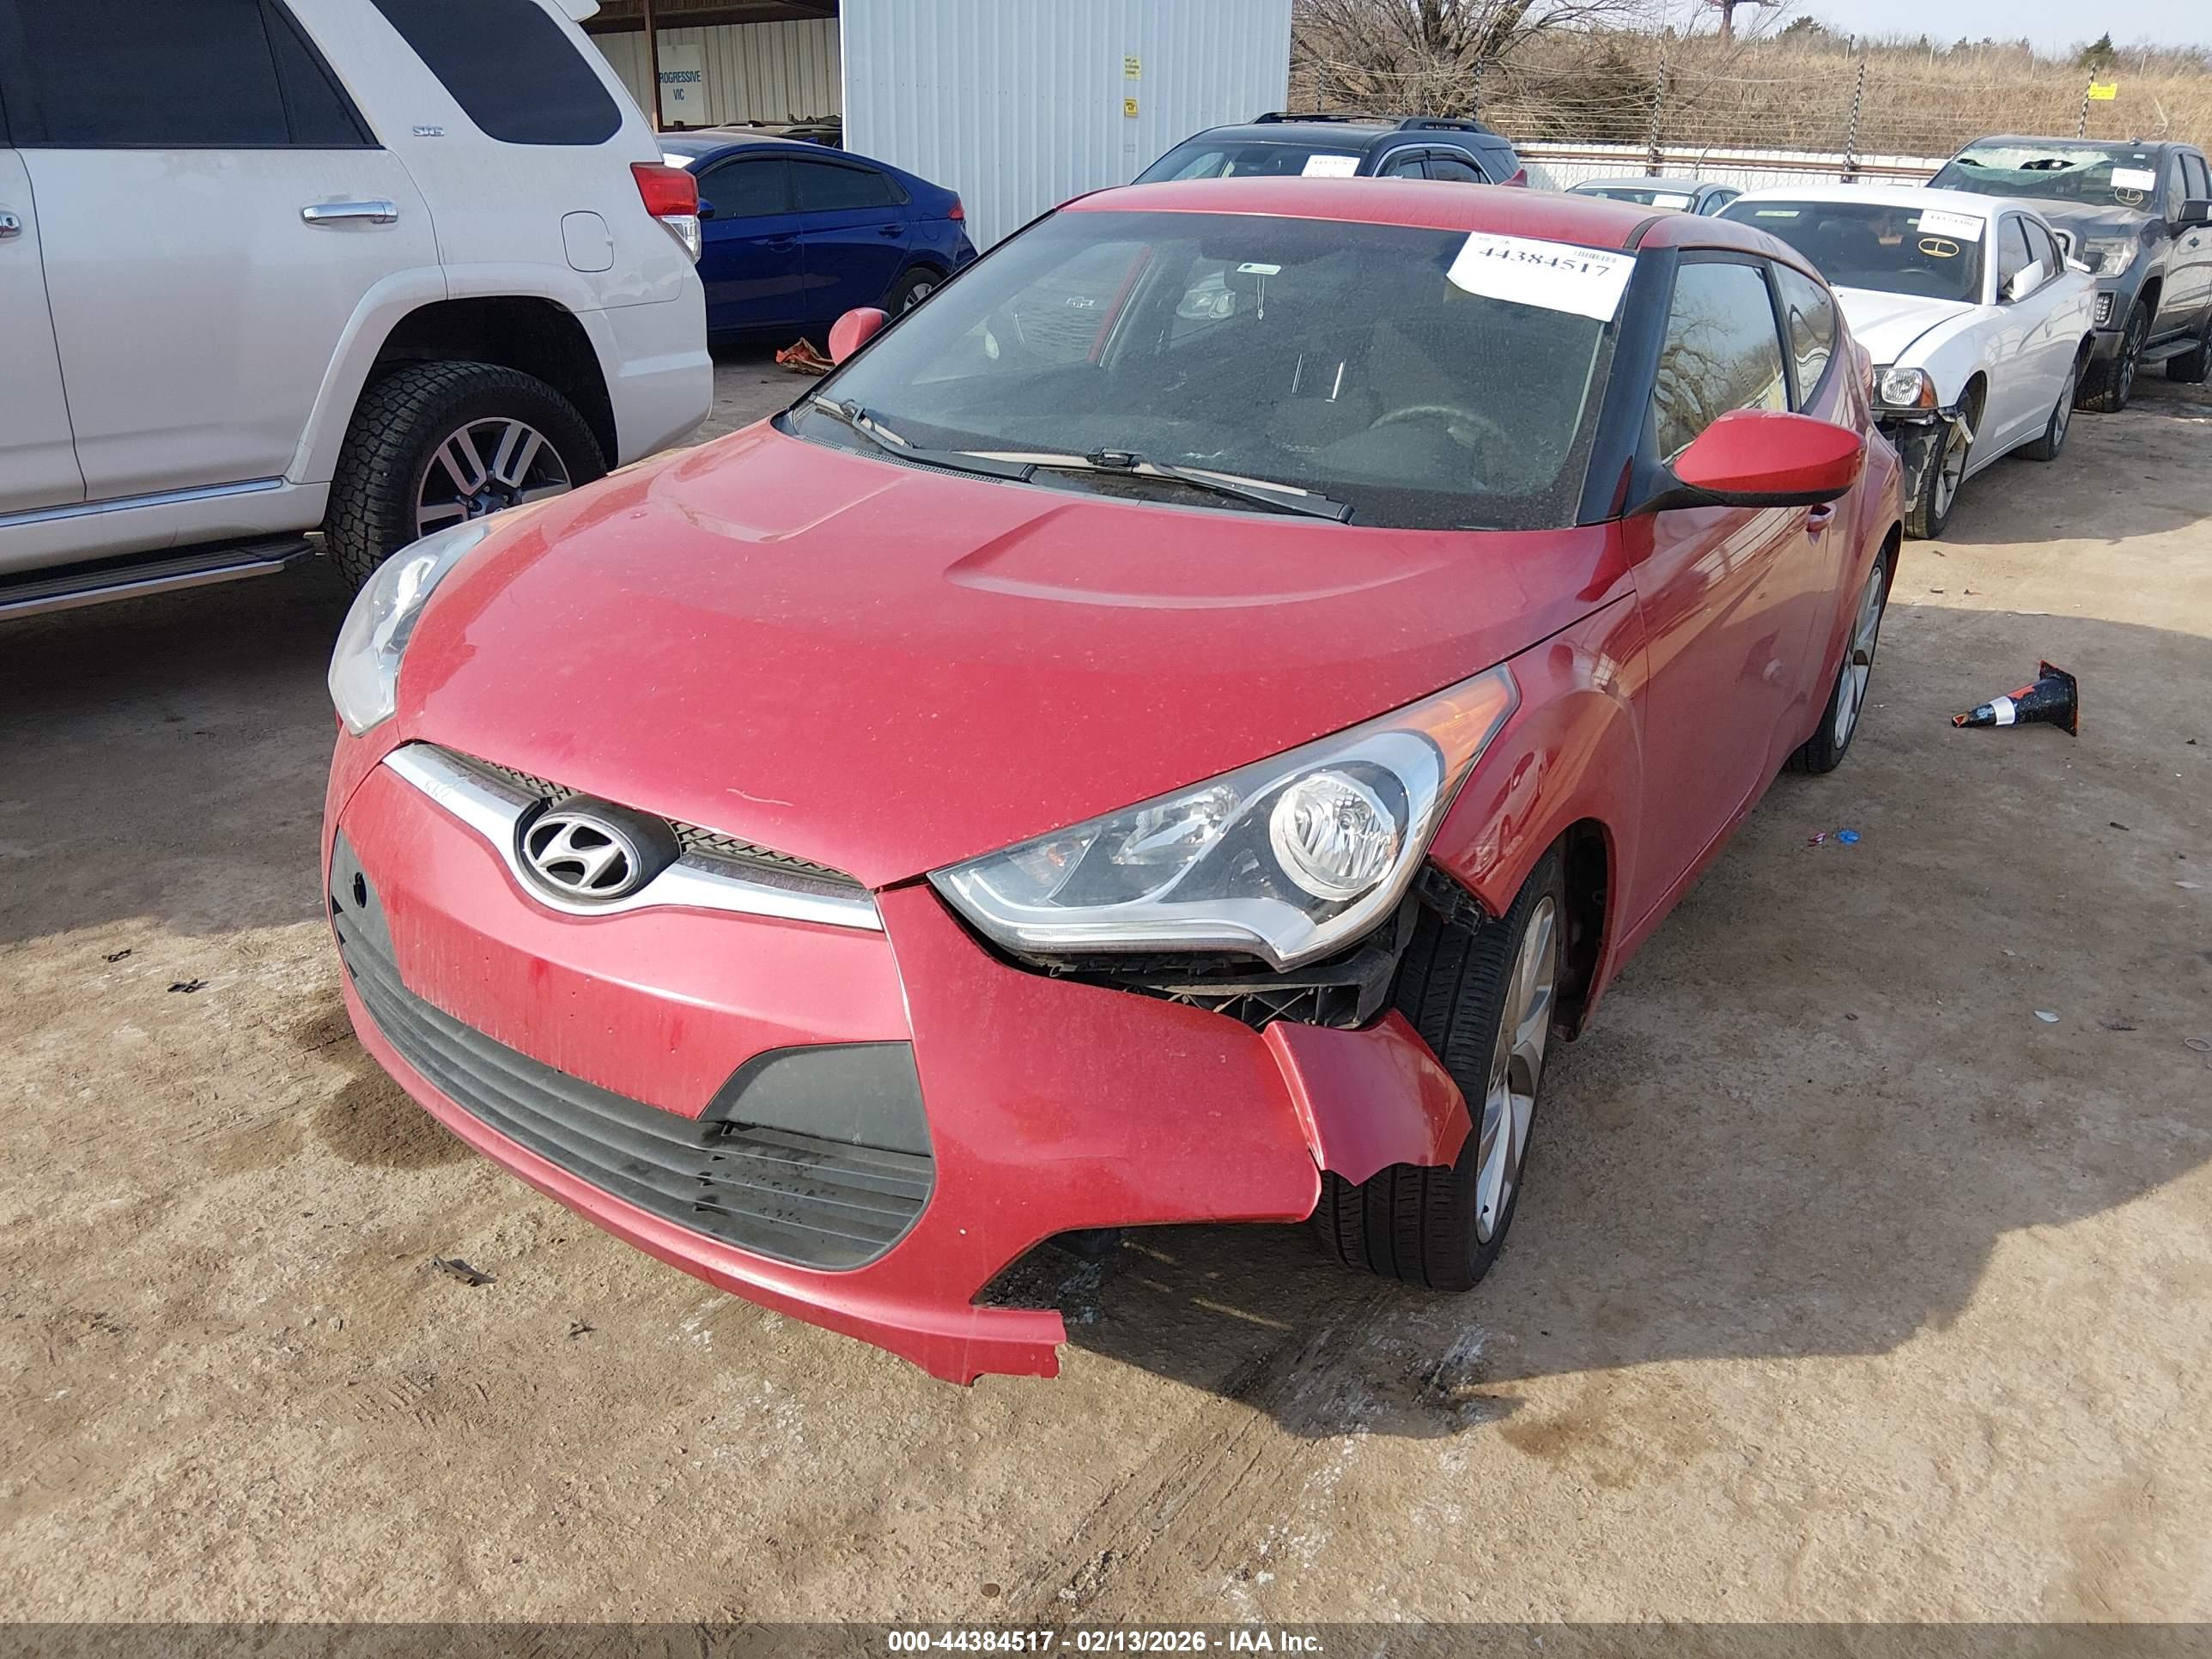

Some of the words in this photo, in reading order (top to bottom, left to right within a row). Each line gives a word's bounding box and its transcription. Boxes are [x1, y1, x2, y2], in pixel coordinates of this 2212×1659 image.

[659, 70, 702, 83] ROGRESSIVE
[673, 88, 685, 100] VIC
[1479, 246, 1611, 276] 44384517
